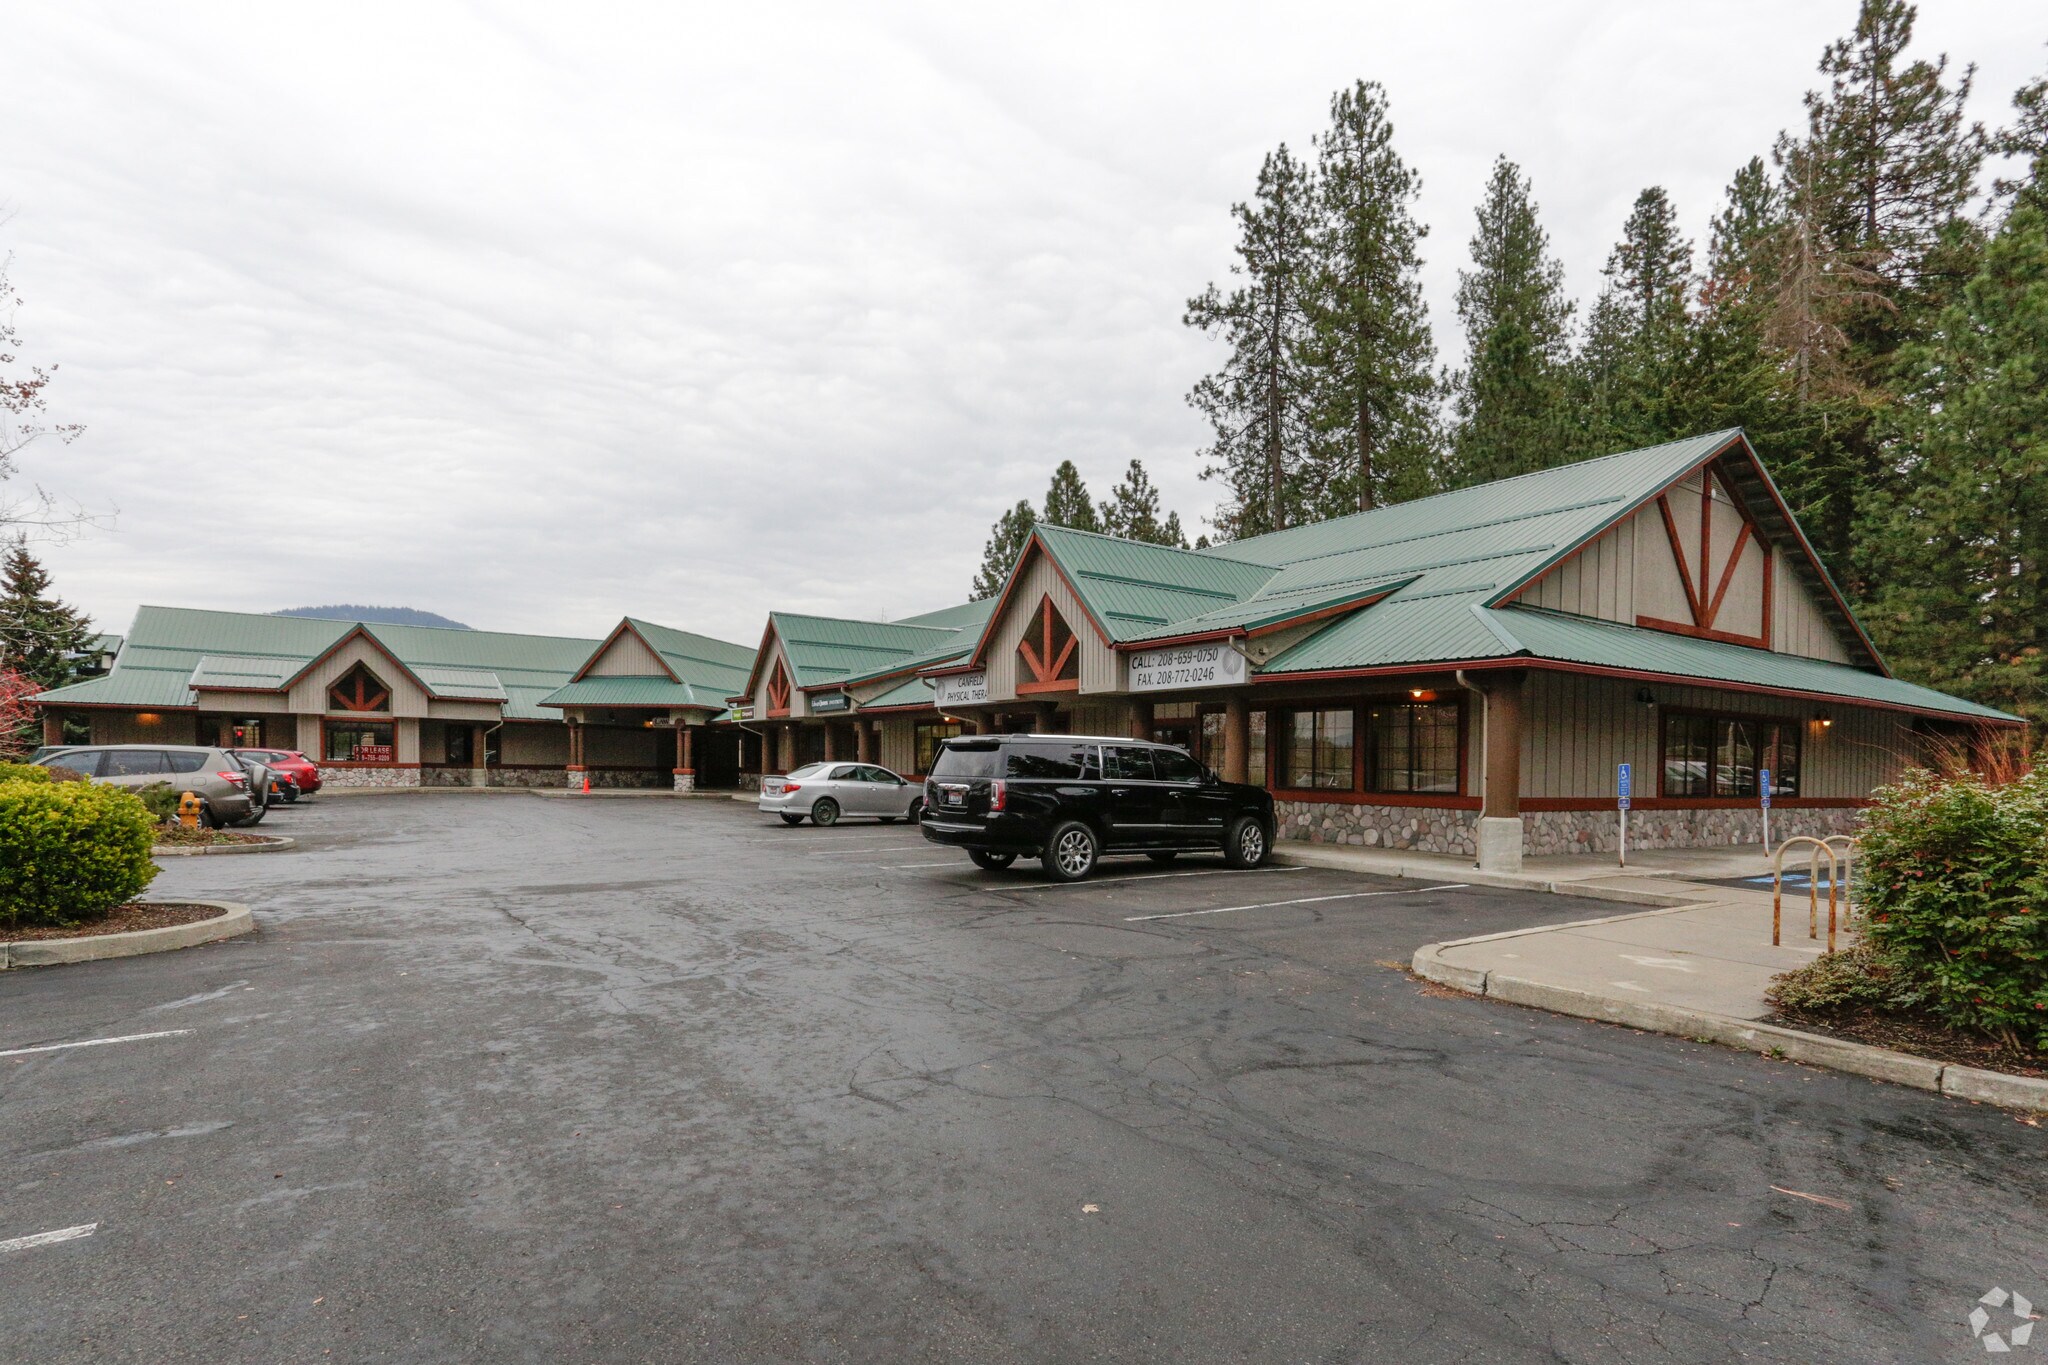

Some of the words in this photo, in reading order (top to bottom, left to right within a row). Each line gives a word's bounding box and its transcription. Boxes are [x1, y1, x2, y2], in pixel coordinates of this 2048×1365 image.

[1132, 656, 1154, 670] CALL:
[1158, 648, 1218, 667] 208-659-0750
[958, 675, 984, 688] CANFIELD
[1157, 667, 1214, 685] 208-772-0246
[947, 691, 970, 702] PHYSICAL
